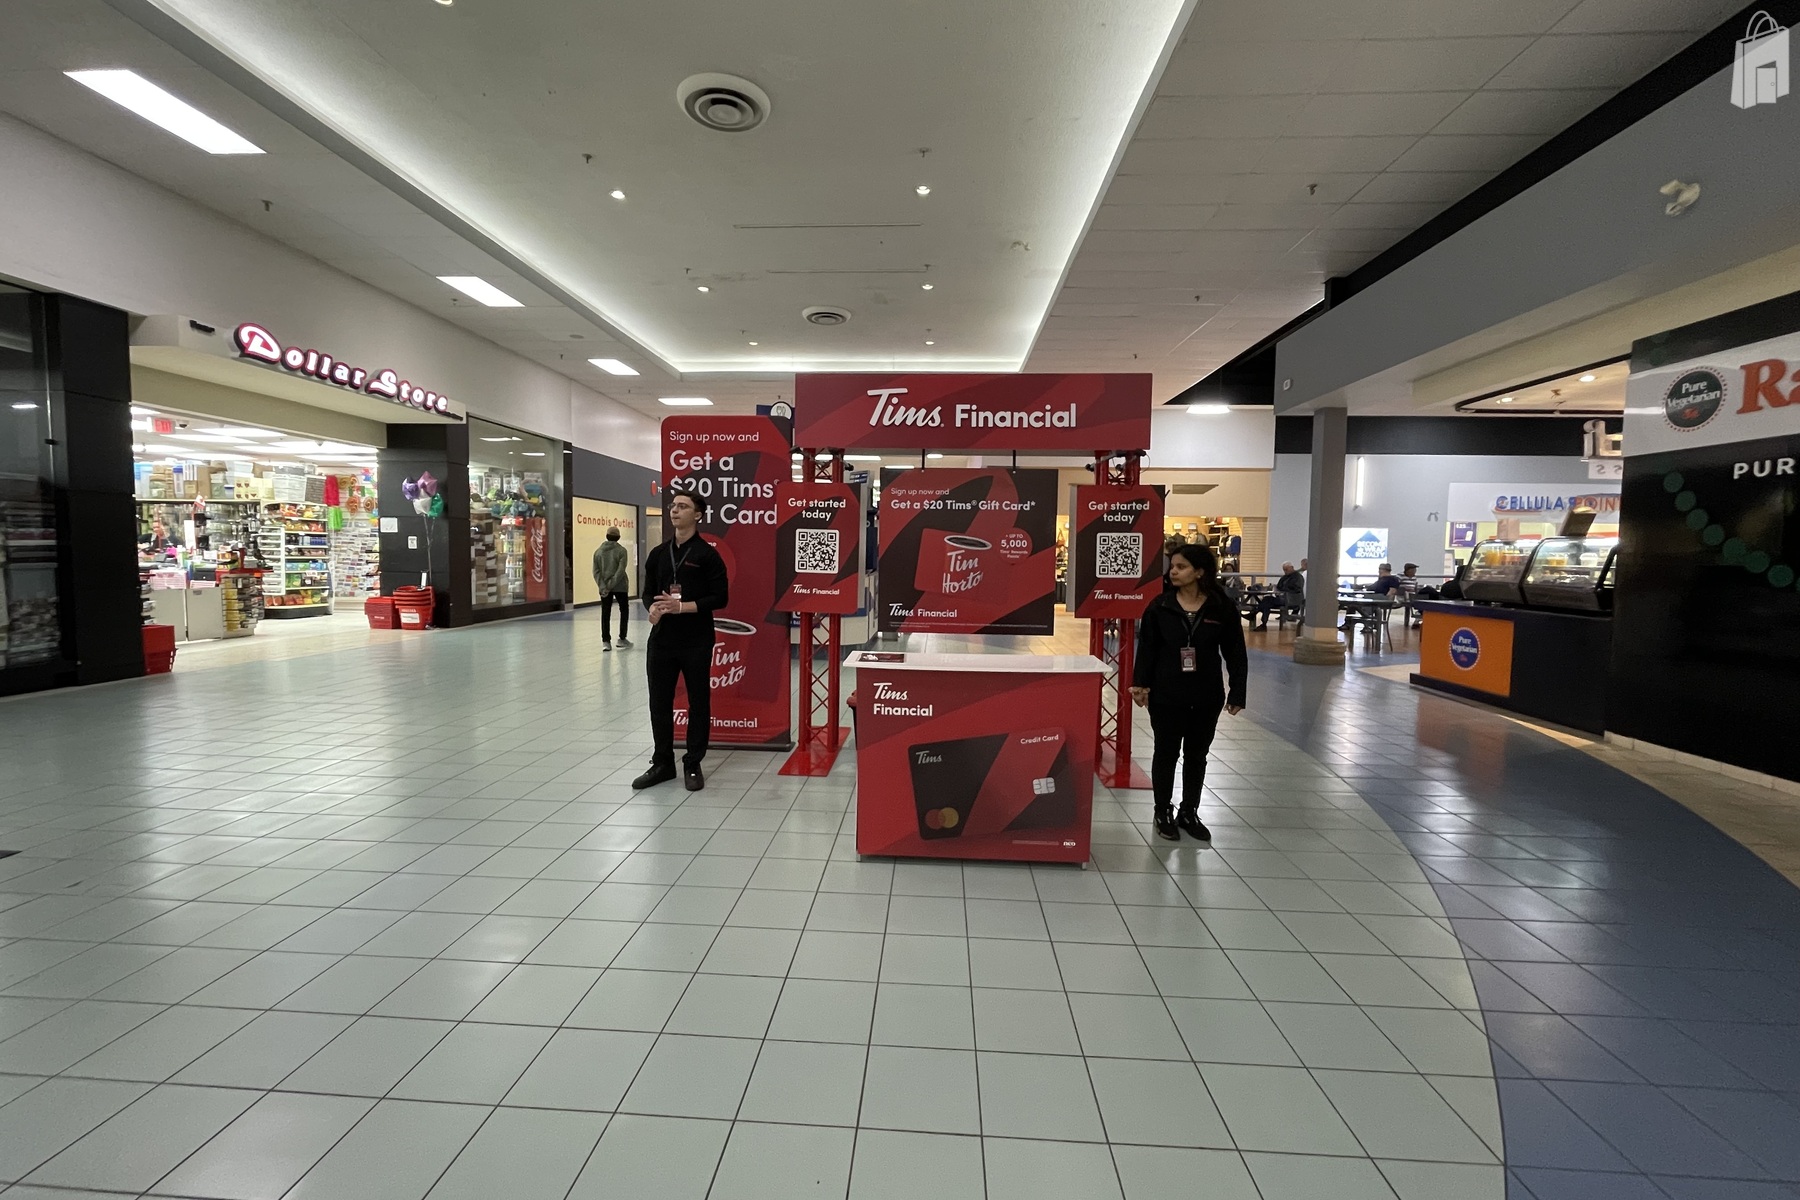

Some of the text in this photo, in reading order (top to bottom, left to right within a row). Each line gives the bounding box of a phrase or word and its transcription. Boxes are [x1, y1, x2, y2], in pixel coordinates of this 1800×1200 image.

[235, 322, 448, 413] Dollar Store
[1681, 381, 1707, 394] Pure
[1667, 390, 1721, 409] Vegetarian
[867, 388, 1077, 428] Tims Financial
[669, 431, 759, 443] Sign up now and
[669, 449, 734, 471] Get a
[1733, 457, 1796, 479] PUR
[670, 475, 712, 497] $20
[890, 488, 906, 496] Sign
[788, 497, 846, 508] Get started
[890, 499, 911, 509] Get
[923, 499, 943, 510] $20
[978, 500, 999, 510] Gift
[1088, 501, 1150, 510] Get started
[577, 513, 634, 528] Cannabis Outlet
[720, 503, 777, 525] Card
[802, 510, 831, 521] today
[1103, 512, 1134, 524] today
[1001, 539, 1028, 549] 5,000
[947, 550, 979, 572] Tim
[793, 584, 811, 594] Tims
[1094, 589, 1112, 600] Tims
[888, 603, 958, 618] Tims Financial
[873, 682, 908, 700] Tims
[873, 703, 933, 717] Financial
[1020, 734, 1059, 744] Credit Card
[916, 750, 942, 765] Tims
